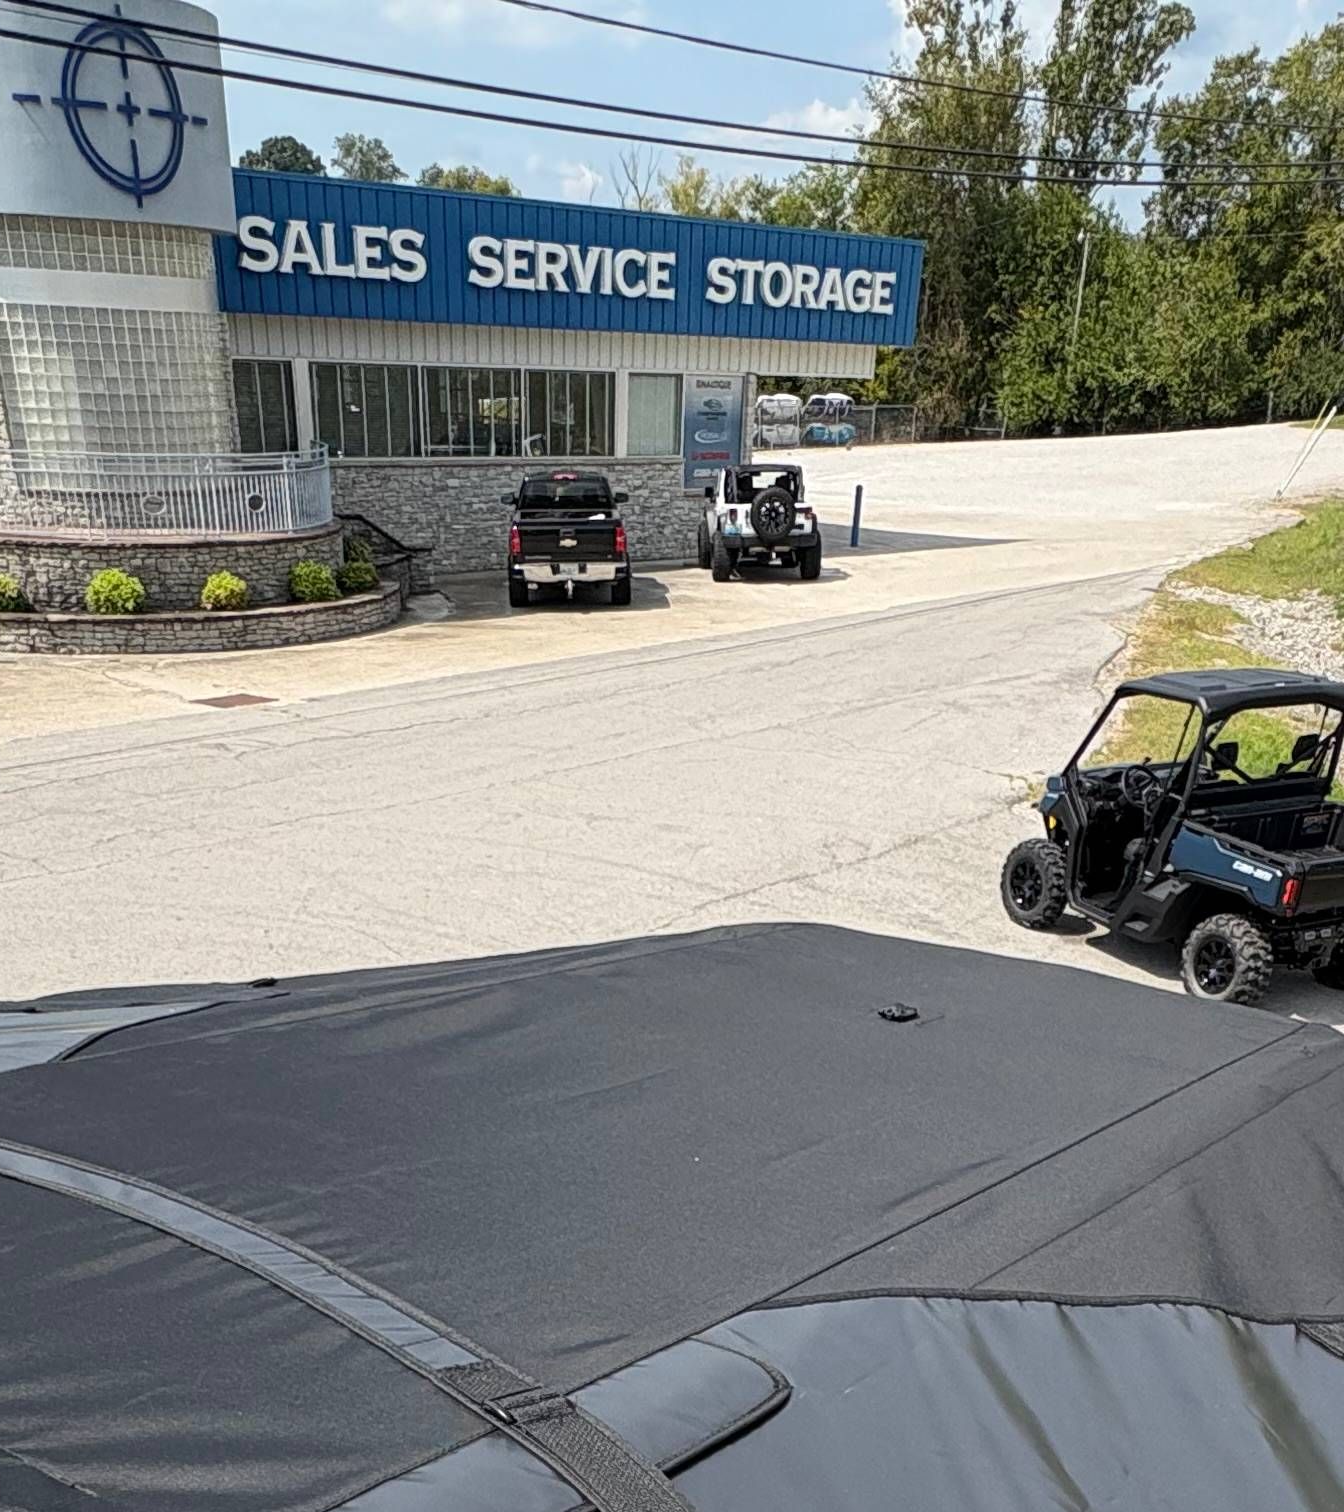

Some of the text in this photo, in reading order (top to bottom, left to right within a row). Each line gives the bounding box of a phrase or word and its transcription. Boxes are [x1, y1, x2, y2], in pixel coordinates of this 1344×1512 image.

[238, 215, 896, 316] SALES SERVICE STORAGE
